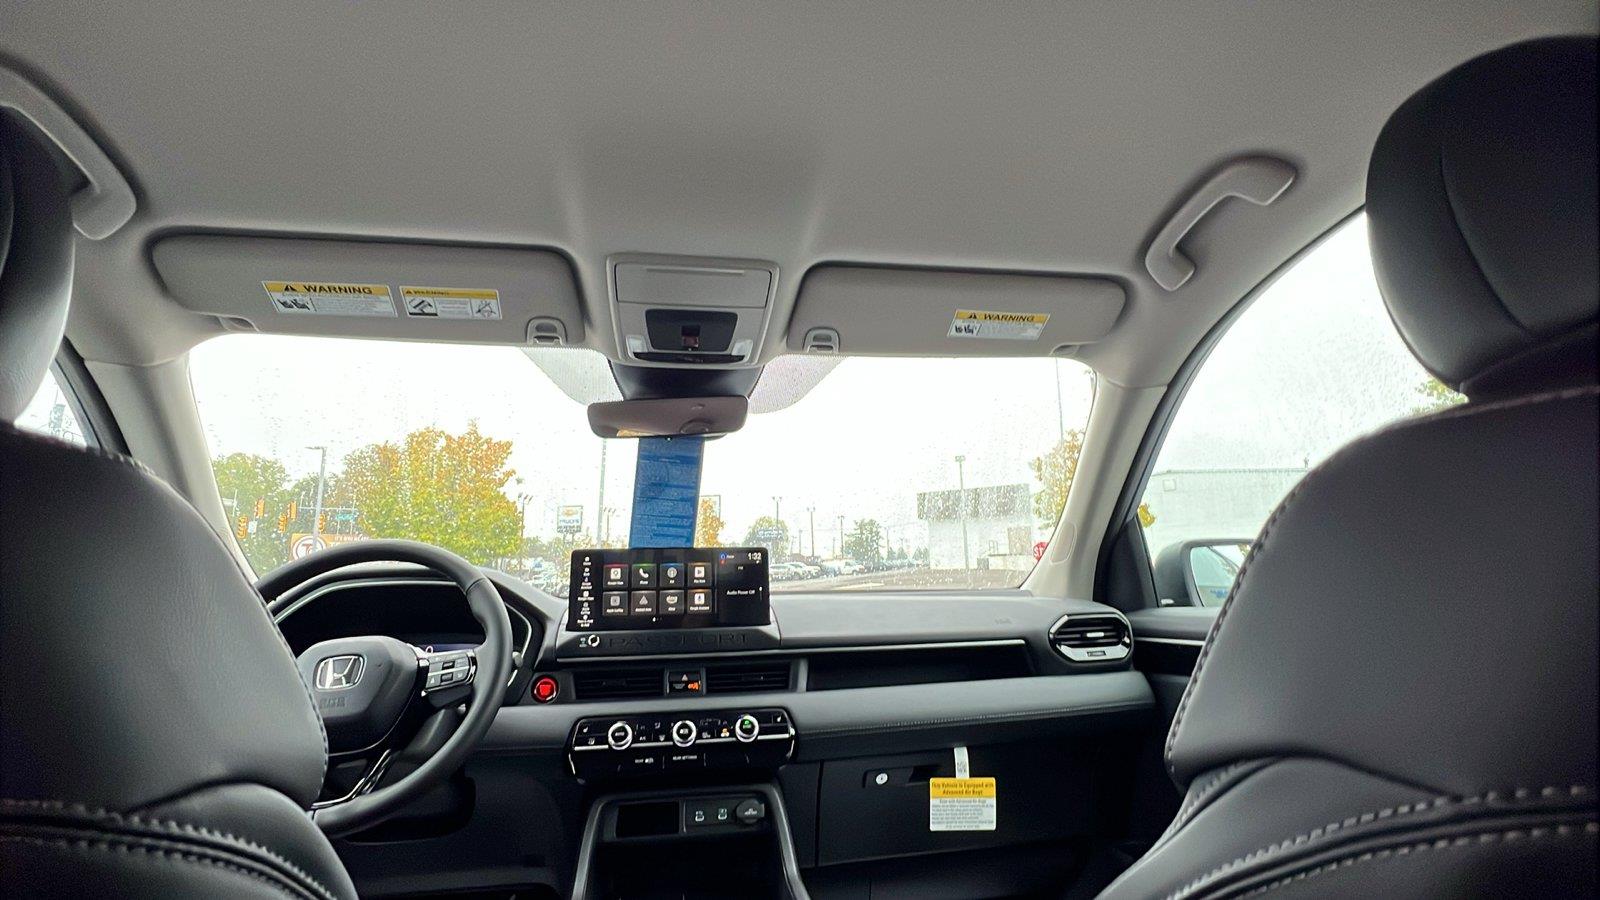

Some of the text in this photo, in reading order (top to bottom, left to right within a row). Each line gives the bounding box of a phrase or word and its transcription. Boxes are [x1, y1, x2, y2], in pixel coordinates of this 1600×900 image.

[303, 285, 373, 295] WARNING
[983, 313, 1035, 322] WARNING
[748, 552, 762, 560] 1:32
